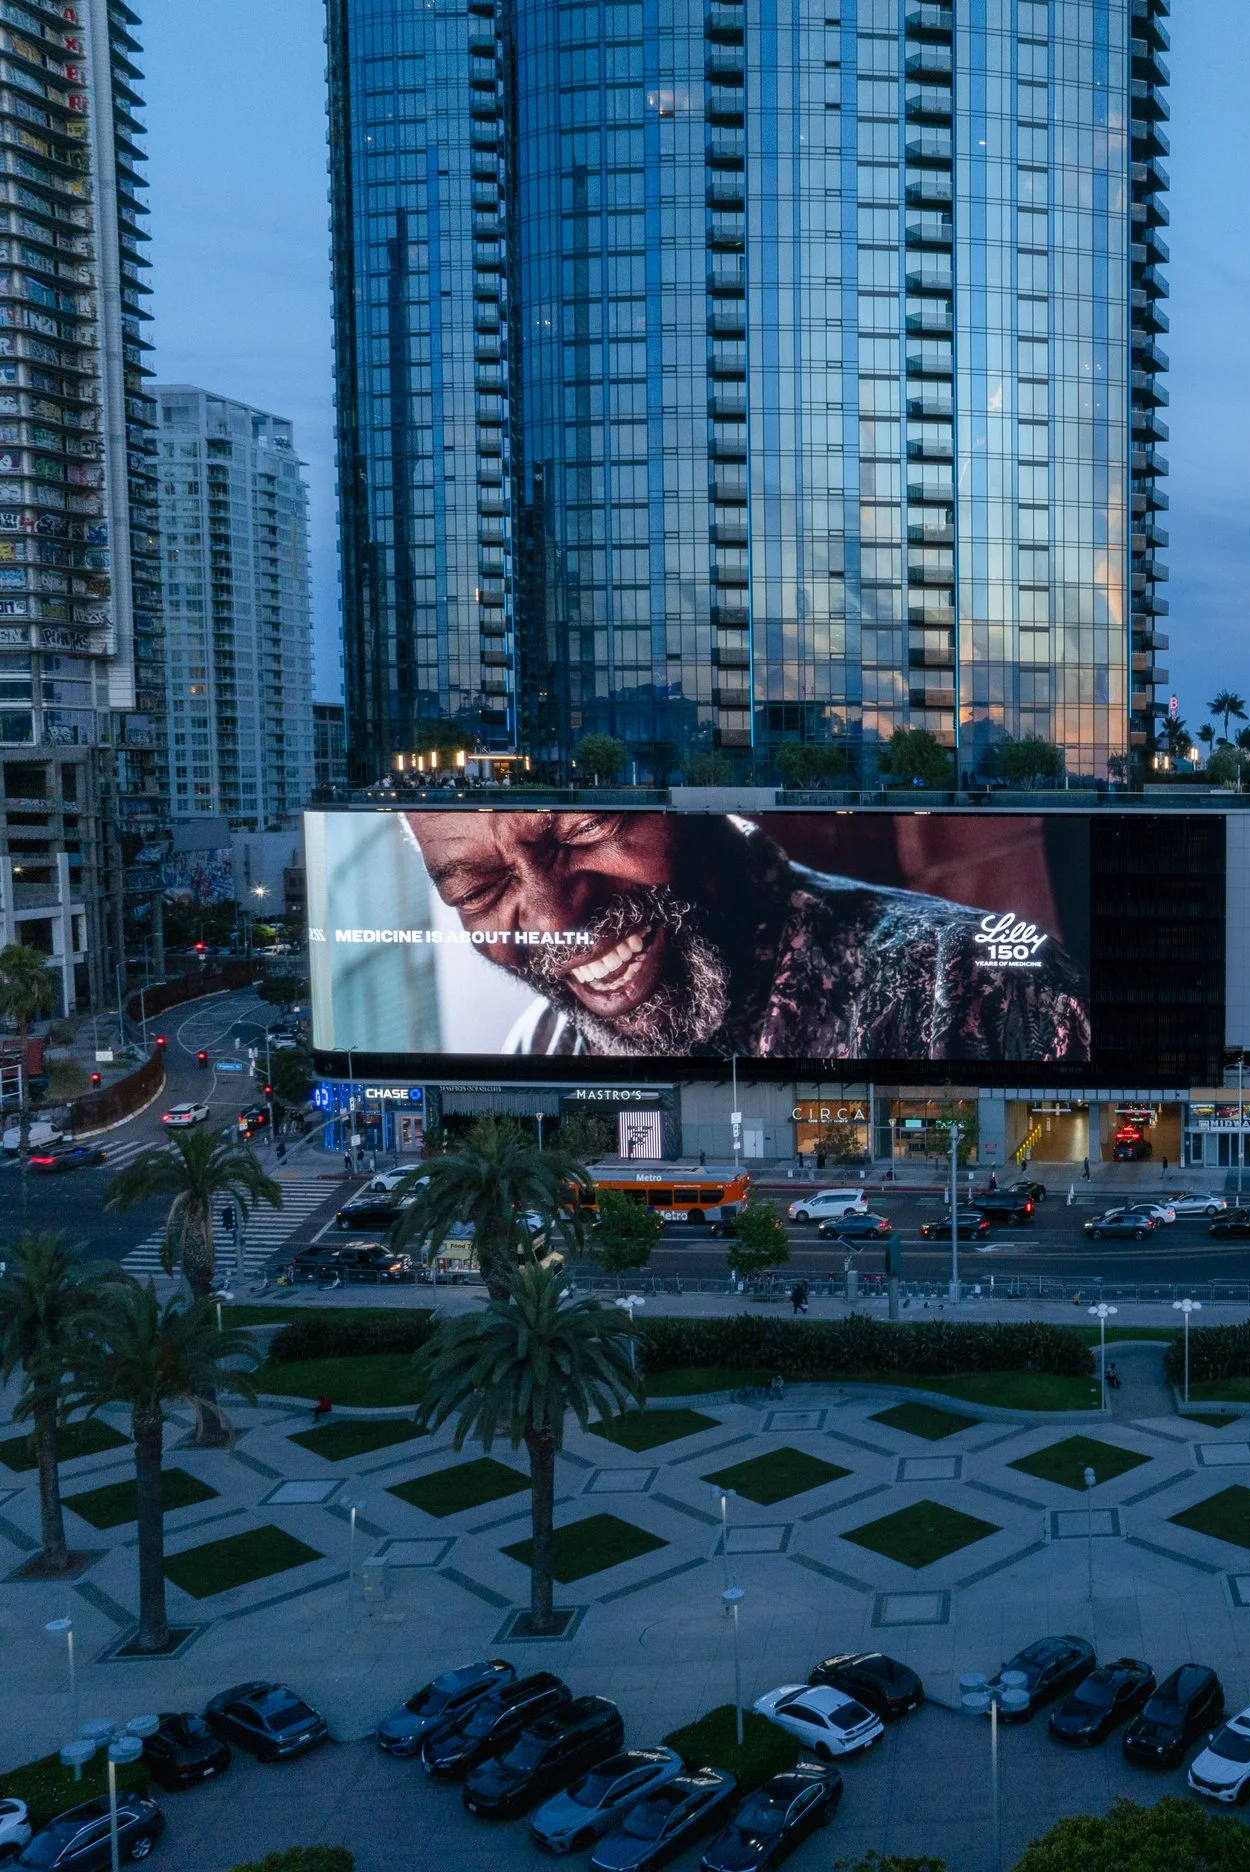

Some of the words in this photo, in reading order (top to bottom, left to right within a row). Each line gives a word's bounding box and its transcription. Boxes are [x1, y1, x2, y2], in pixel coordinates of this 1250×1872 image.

[335, 929, 423, 943] MEDICINE
[425, 930, 442, 943] IS
[443, 930, 511, 944] ABOUT
[515, 931, 594, 945] HEALTH.
[974, 912, 1048, 954] Lilly
[987, 945, 1029, 960] 150
[365, 1088, 409, 1100] CHASE
[576, 1089, 642, 1101] MASTRO'S
[792, 1107, 866, 1121] CIRCA
[636, 1173, 663, 1182] Metro
